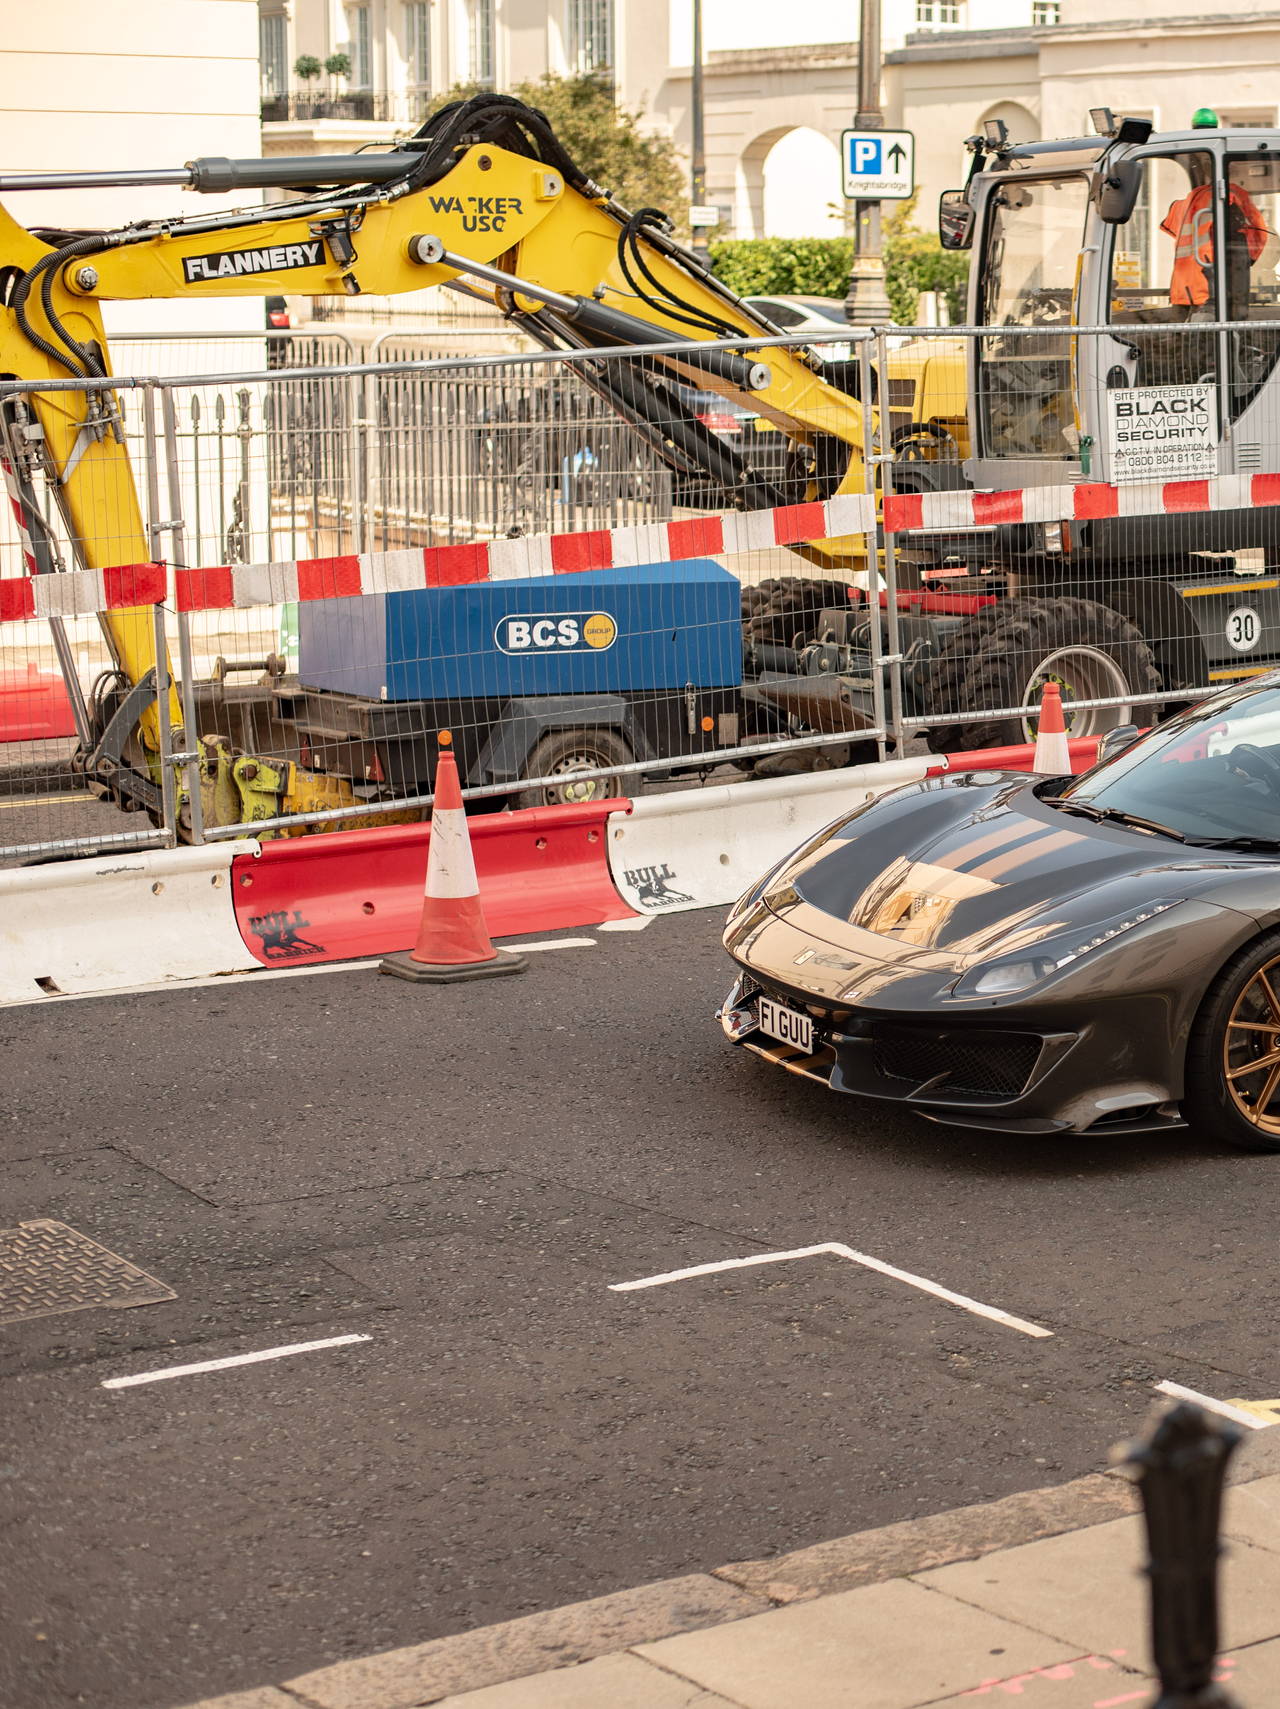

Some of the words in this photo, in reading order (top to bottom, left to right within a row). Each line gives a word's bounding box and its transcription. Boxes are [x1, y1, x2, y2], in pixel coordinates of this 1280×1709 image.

[855, 140, 877, 173] P
[848, 180, 908, 191] Knightsbridge
[186, 242, 320, 281] FLANNERY
[1114, 391, 1135, 401] SITE
[1138, 388, 1193, 399] PROTECTED
[1196, 387, 1209, 396] BY
[1116, 398, 1208, 417] BLACK
[1116, 413, 1209, 431] DIAMOND
[1117, 426, 1209, 442] SECURITY
[1153, 445, 1162, 454] IN
[1162, 442, 1205, 454] OPERATION
[1128, 456, 1154, 466] 0800
[1156, 454, 1175, 465] 804
[1177, 452, 1202, 463] 8112
[1113, 462, 1216, 476] www.blackdiamondsecurity.co.uk
[508, 619, 579, 648] BCS
[586, 627, 611, 635] GROUP
[1232, 614, 1254, 643] 30
[623, 863, 677, 886] BULL
[248, 911, 310, 934] BULL
[779, 1010, 809, 1048] GUU
